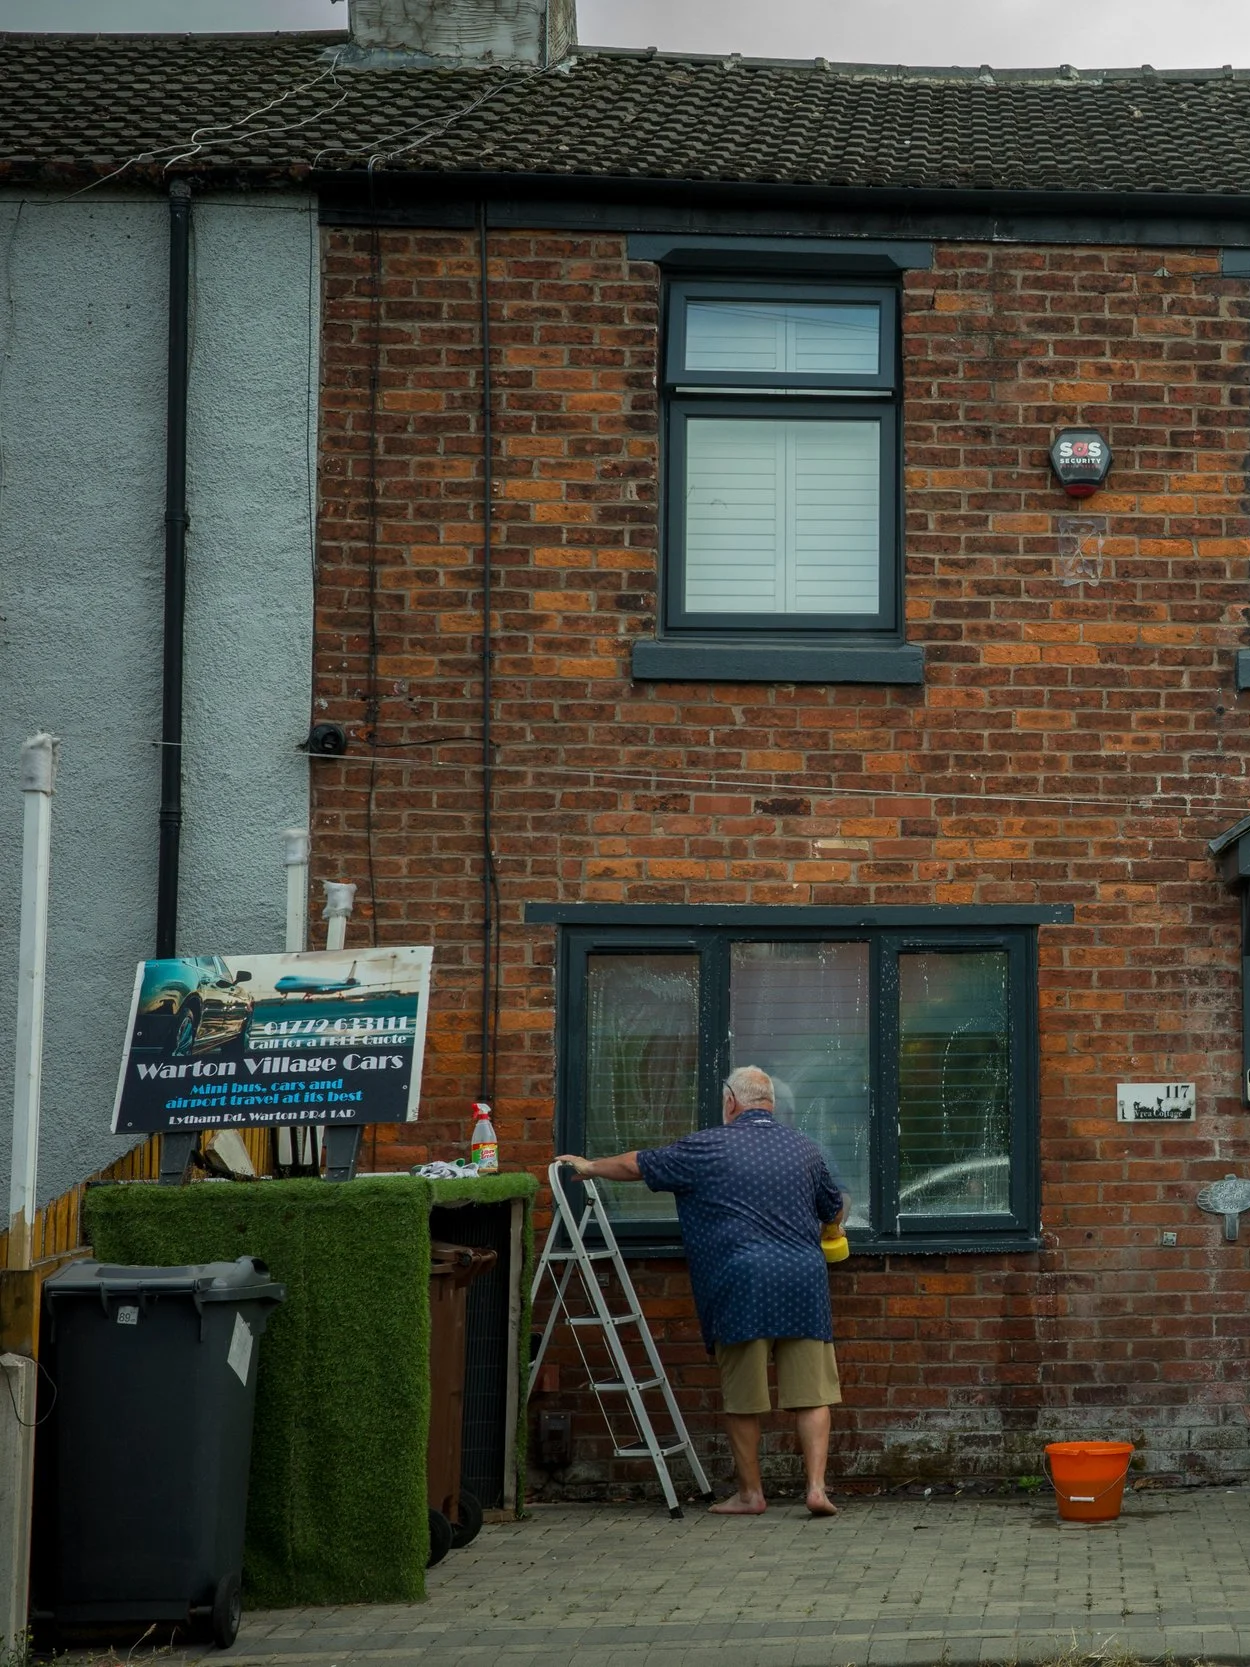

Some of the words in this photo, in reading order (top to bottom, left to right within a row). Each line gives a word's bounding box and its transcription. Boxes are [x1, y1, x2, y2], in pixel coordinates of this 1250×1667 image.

[1060, 442, 1101, 457] SOS
[264, 1019, 329, 1035] 01772
[334, 1016, 408, 1032] 633111
[249, 1039, 279, 1050] Call
[282, 1038, 302, 1048] for
[306, 1039, 317, 1047] a
[362, 1034, 407, 1046] Quote
[137, 1060, 237, 1081] Warton
[243, 1056, 337, 1076] Village
[343, 1053, 404, 1071] Cars
[190, 1083, 228, 1095] Mini
[270, 1081, 306, 1092] cars
[308, 1078, 343, 1091] and
[1166, 1085, 1190, 1099] 117
[165, 1095, 227, 1109] airport
[230, 1093, 279, 1106] travel
[282, 1091, 302, 1104] at
[303, 1091, 325, 1103] its
[327, 1089, 364, 1103] best
[168, 1115, 221, 1126] Lytham
[249, 1111, 298, 1122] Warton
[299, 1110, 326, 1120] PR4
[330, 1109, 356, 1119] 1AD
[119, 1312, 130, 1322] 89
